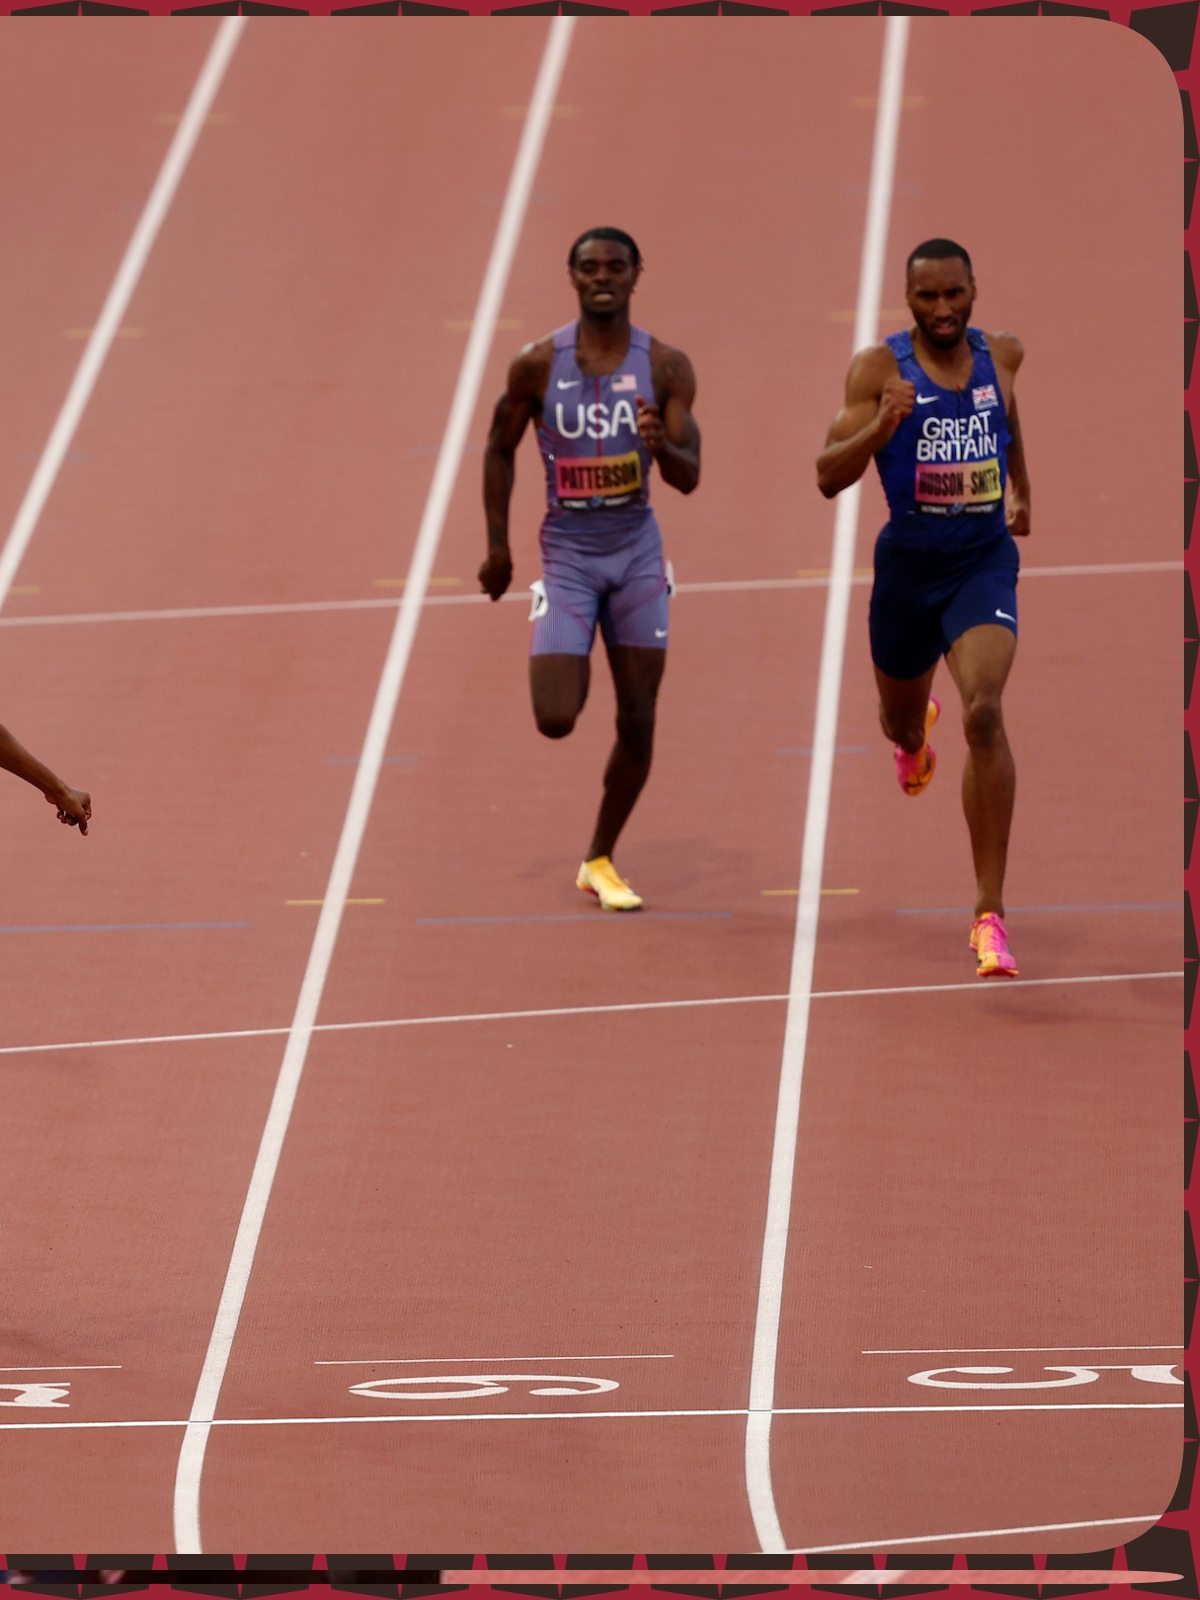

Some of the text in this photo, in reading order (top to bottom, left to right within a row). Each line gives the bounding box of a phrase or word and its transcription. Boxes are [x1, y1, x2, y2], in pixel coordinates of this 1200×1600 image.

[555, 400, 638, 439] USA
[922, 410, 991, 441] GREAT
[916, 432, 997, 461] BRITAIN
[560, 460, 637, 490] PATTERSON
[349, 1375, 620, 1400] 6
[907, 1364, 1184, 1389] 5
